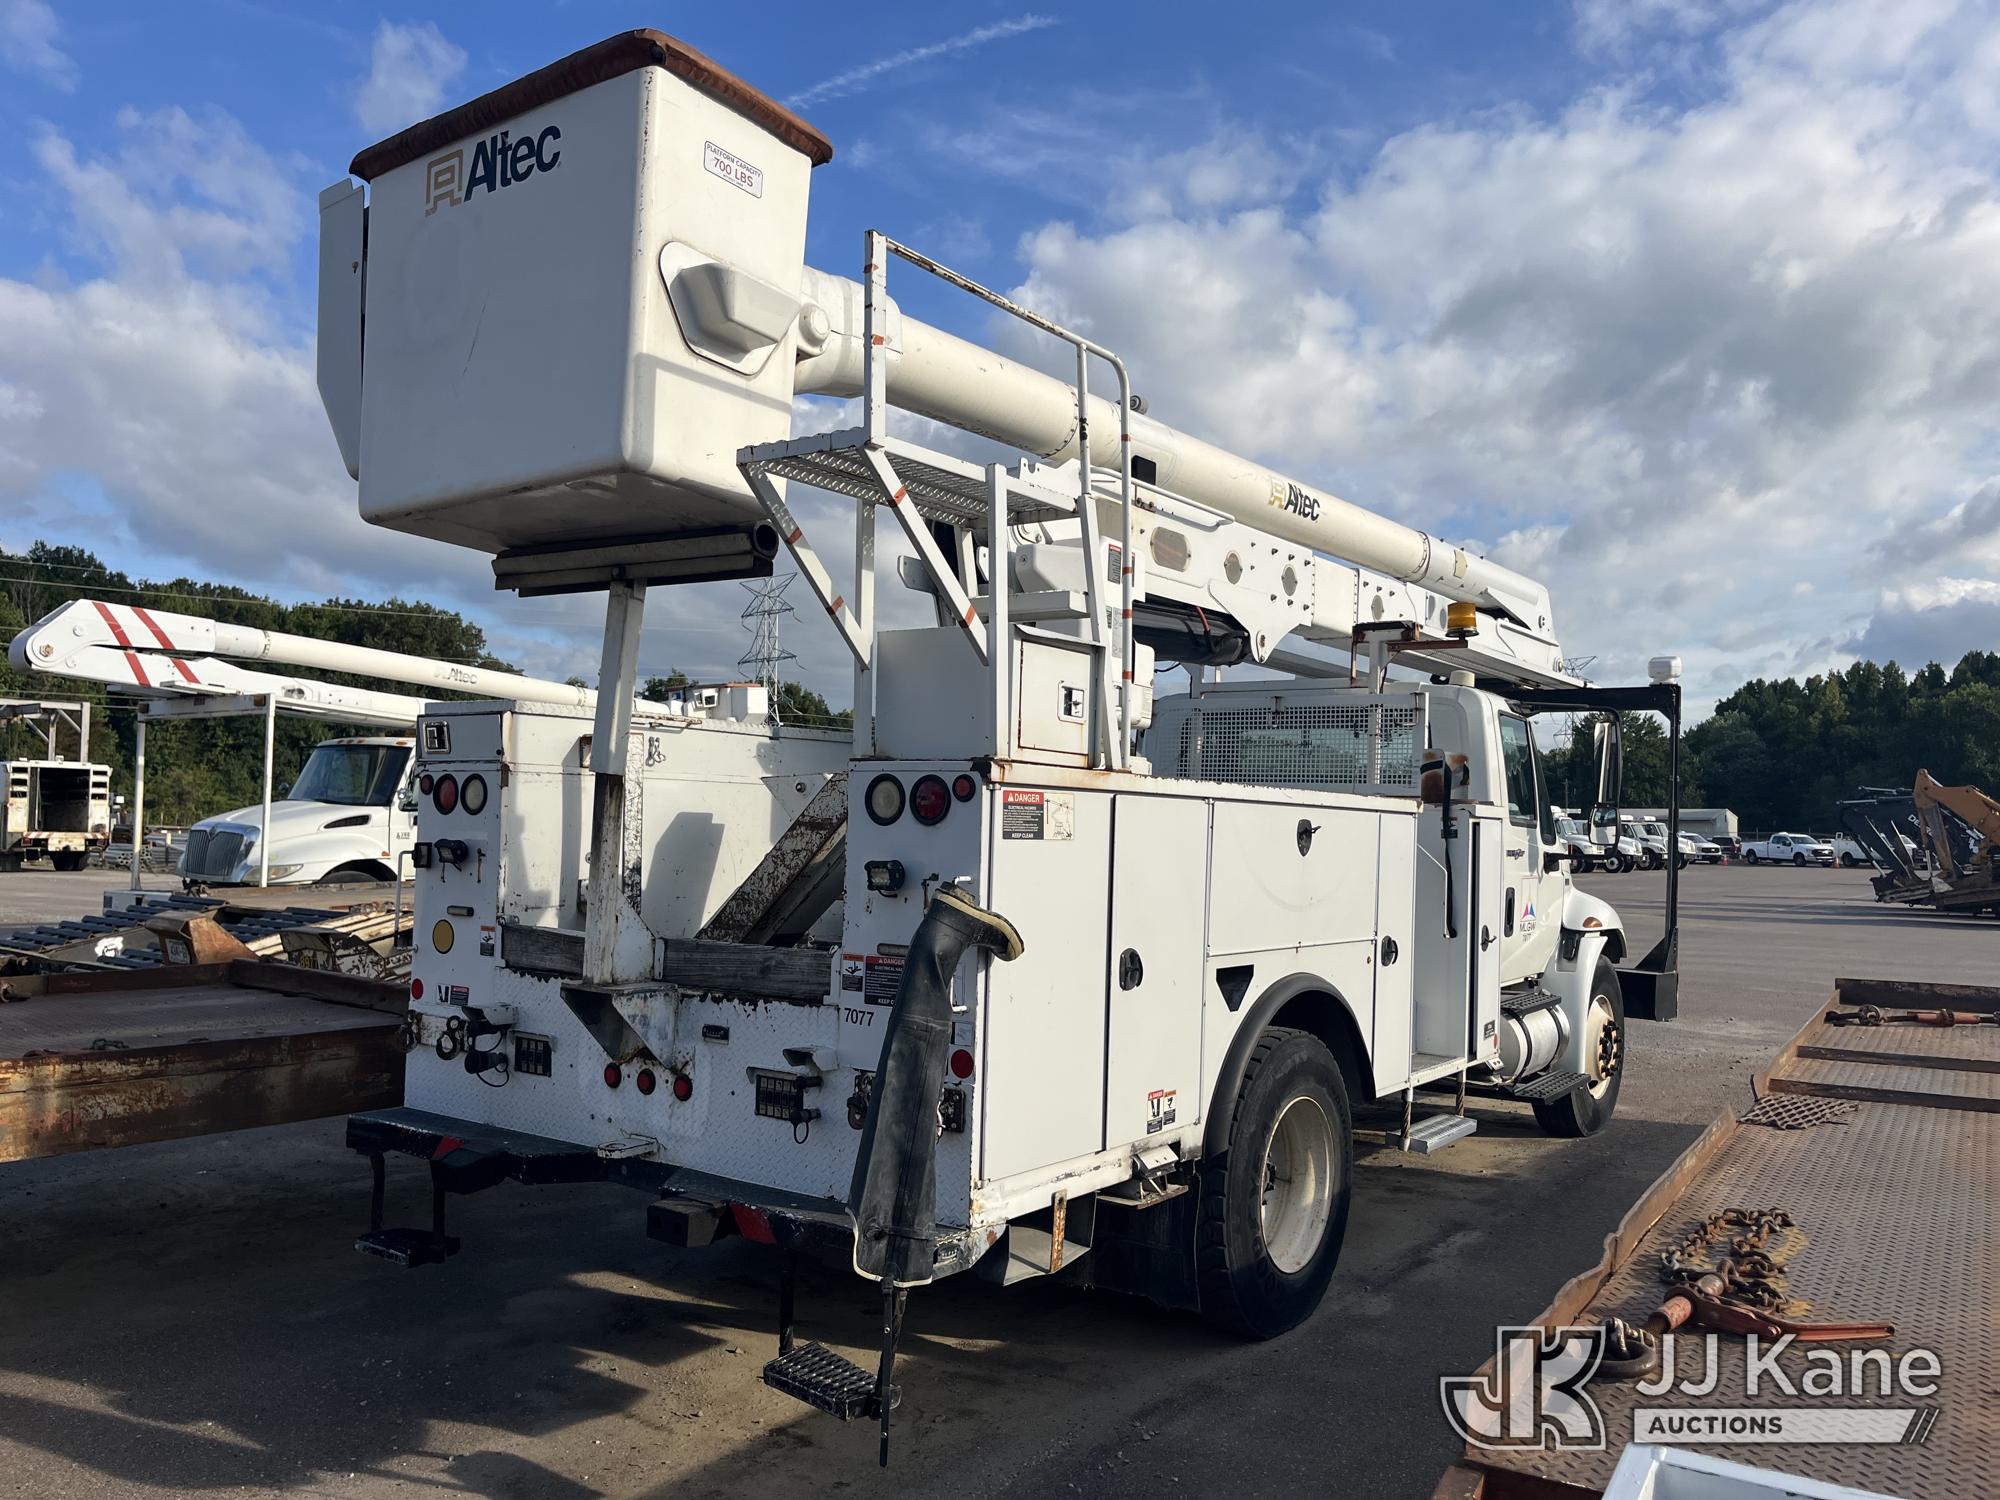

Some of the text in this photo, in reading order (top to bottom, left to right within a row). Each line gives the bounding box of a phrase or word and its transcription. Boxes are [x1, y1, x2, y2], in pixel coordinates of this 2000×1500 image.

[464, 125, 562, 202] Altec
[707, 143, 761, 178] PLATFORM CAPACITY
[713, 156, 732, 175] 700
[735, 168, 754, 187] LBS
[1284, 482, 1320, 521] Altec
[447, 667, 478, 684] Altec
[1014, 793, 1040, 803] DANGER
[844, 1008, 874, 1027] 7077
